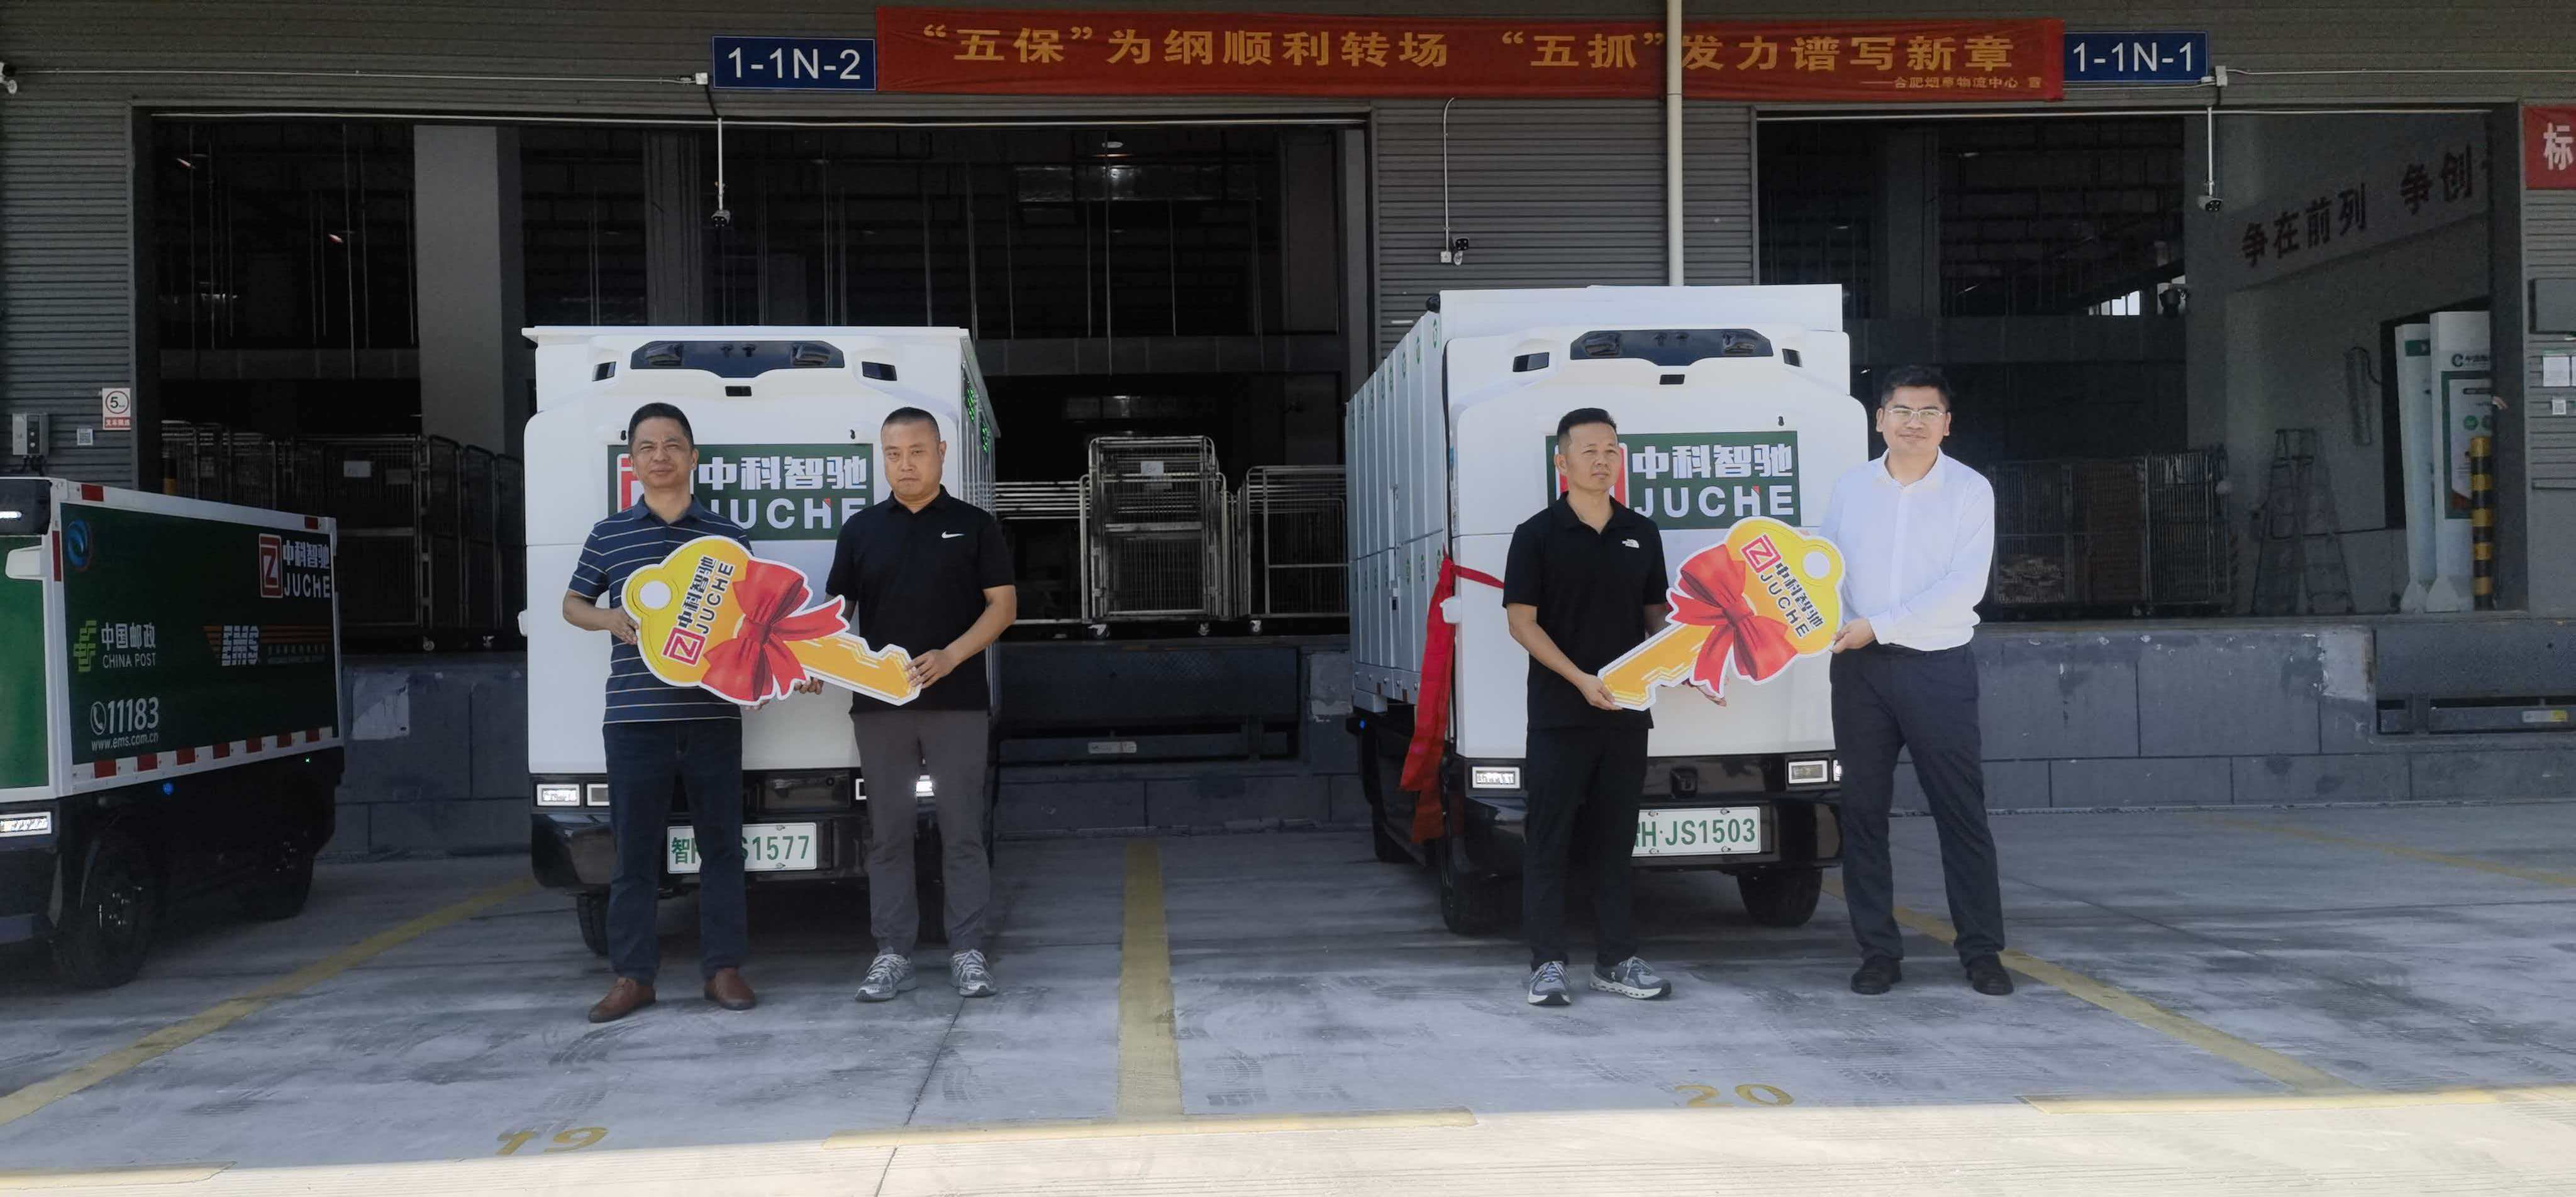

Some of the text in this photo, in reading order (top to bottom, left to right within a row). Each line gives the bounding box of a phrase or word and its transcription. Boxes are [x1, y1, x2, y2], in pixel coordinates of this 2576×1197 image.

[727, 47, 862, 80] 1-1N-2
[2073, 41, 2194, 73] 1-1N-1
[2543, 122, 2574, 171] 标
[2242, 182, 2366, 267] 争在前列
[110, 397, 118, 408] 5
[698, 455, 867, 491] 中科智驰
[1632, 443, 1793, 480] 中科智驰
[1635, 485, 1794, 518] JUCHE
[282, 539, 330, 570] 中科智驰
[284, 572, 331, 598] JUCHE
[677, 556, 717, 628] 中科智驰
[696, 562, 734, 635] JUCHE
[1775, 562, 1824, 627] 中科智驰
[1760, 573, 1811, 637] JUCHE
[101, 622, 157, 651] 中国邮政
[221, 624, 259, 666] EMS
[103, 652, 157, 669] CHINA POST
[107, 697, 160, 734] 11183
[91, 732, 160, 751] www.ems.com.cn
[1674, 1083, 1796, 1108] 20
[495, 1126, 609, 1156] 19
